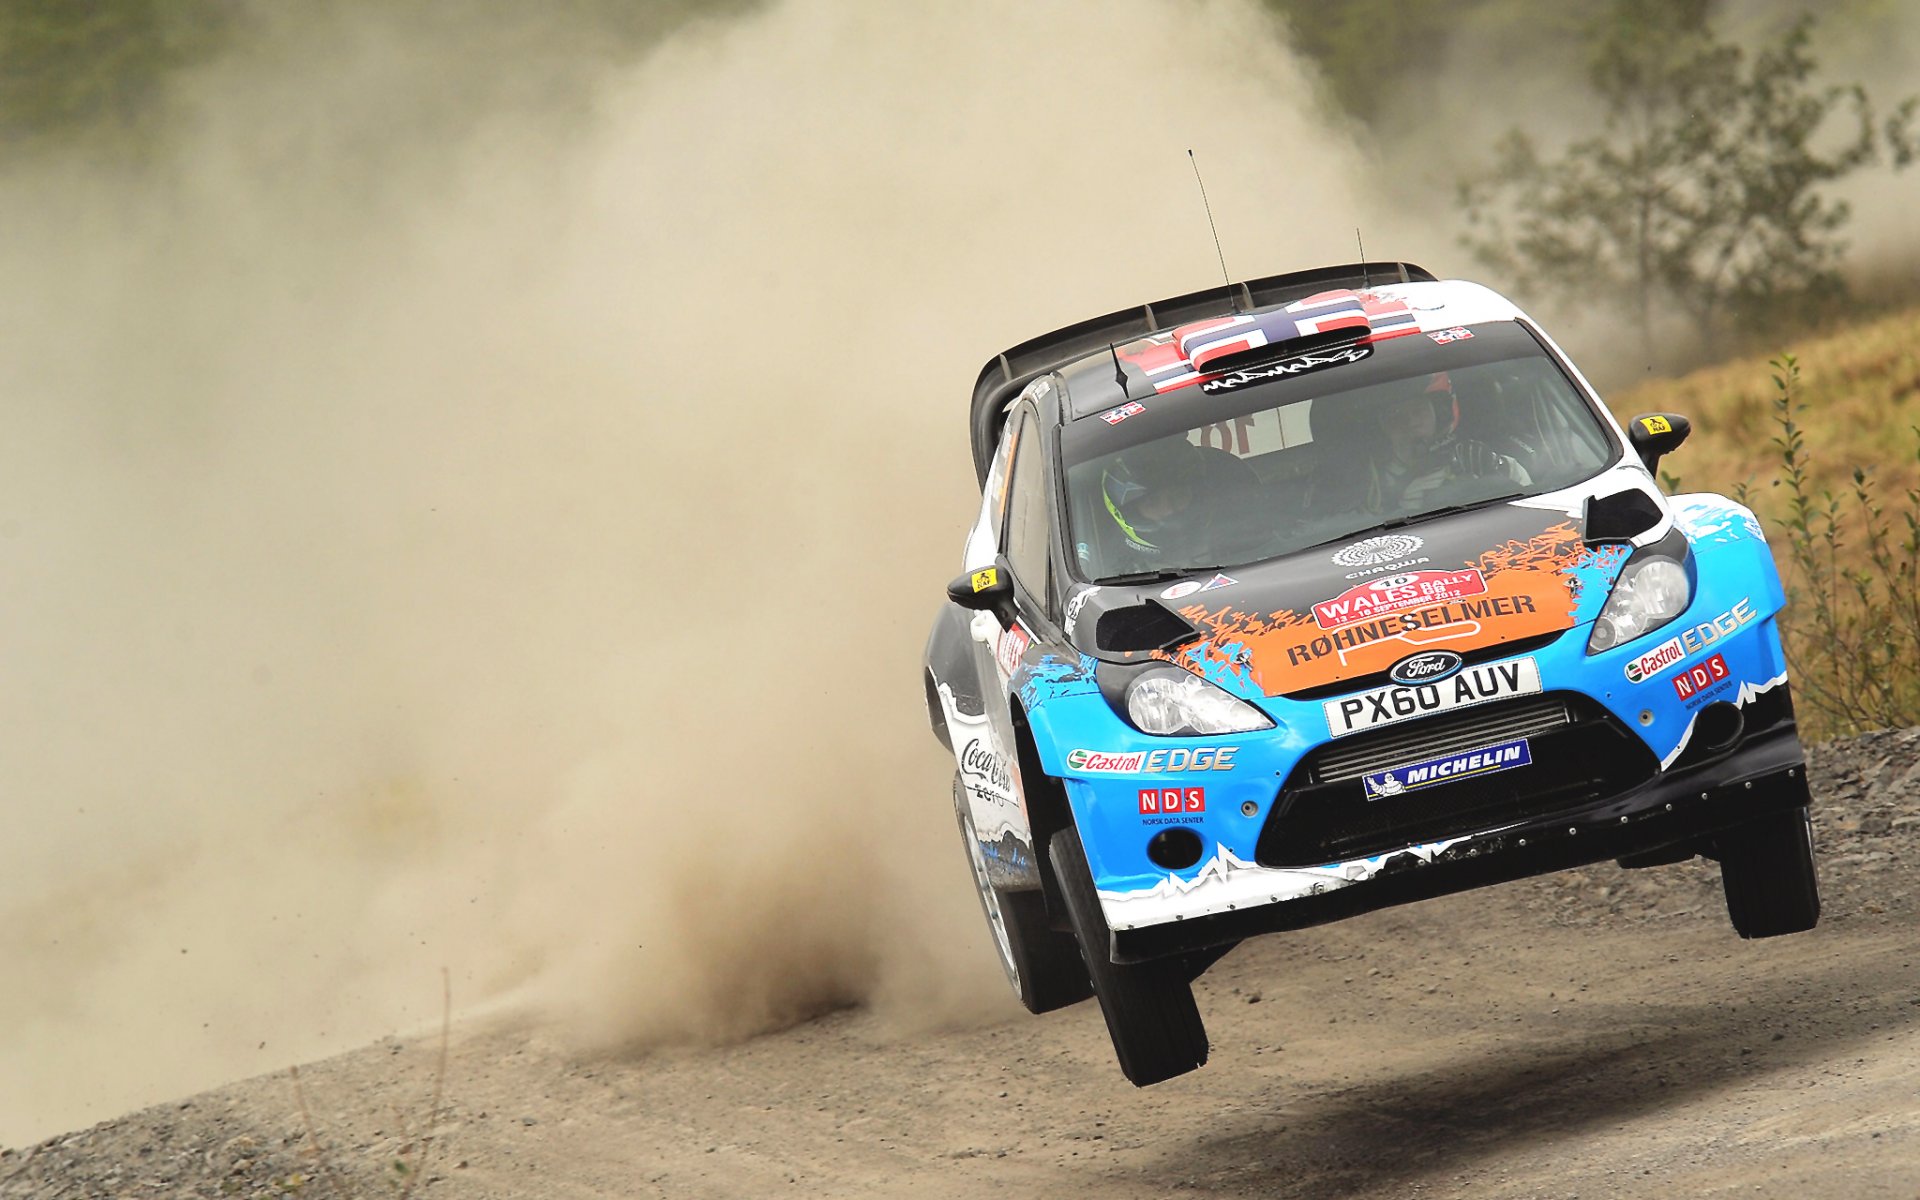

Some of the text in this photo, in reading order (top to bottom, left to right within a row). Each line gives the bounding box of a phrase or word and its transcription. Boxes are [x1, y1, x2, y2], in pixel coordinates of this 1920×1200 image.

[1345, 556, 1430, 580] CHAQWA
[1379, 577, 1408, 588] 10
[1422, 585, 1447, 595] GB
[1320, 574, 1473, 619] WALES RALLY
[1373, 594, 1433, 613] SEPTEMBER
[1434, 589, 1461, 600] 2012
[1287, 595, 1536, 666] RØHNESELMER
[1640, 597, 1757, 676] Castrol EDGE
[1406, 656, 1446, 678] Ford
[1675, 657, 1725, 697] NDS
[1340, 663, 1519, 729] PX60 AUV
[1086, 746, 1241, 774] Castrol EDGE
[1407, 746, 1520, 784] MICHELIN
[1142, 789, 1200, 811] NDS
[1142, 818, 1164, 826] NORSK
[1181, 816, 1205, 824] SENTER
